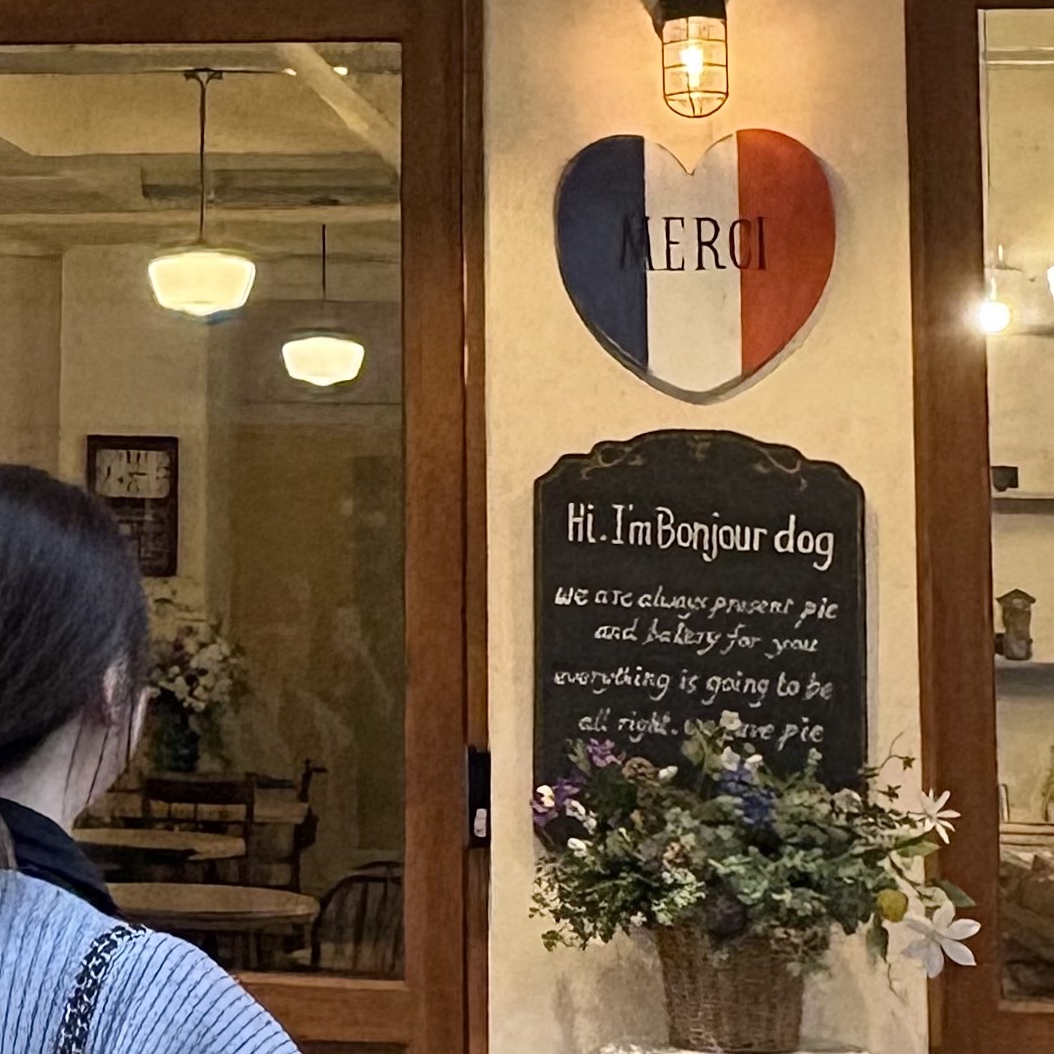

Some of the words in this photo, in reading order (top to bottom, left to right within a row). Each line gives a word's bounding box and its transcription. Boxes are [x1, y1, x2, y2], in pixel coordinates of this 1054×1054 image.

[619, 214, 768, 272] MERCI
[611, 503, 652, 546] I'm
[655, 506, 768, 562] Bonjour
[773, 513, 835, 571] dog
[594, 589, 634, 608] are
[594, 617, 639, 641] and
[719, 623, 762, 656] for
[554, 666, 671, 701] everything
[679, 668, 698, 695] is
[701, 670, 770, 708] going
[776, 671, 801, 697] to
[803, 671, 834, 700] be
[578, 707, 611, 732] all
[776, 716, 825, 752] pie
